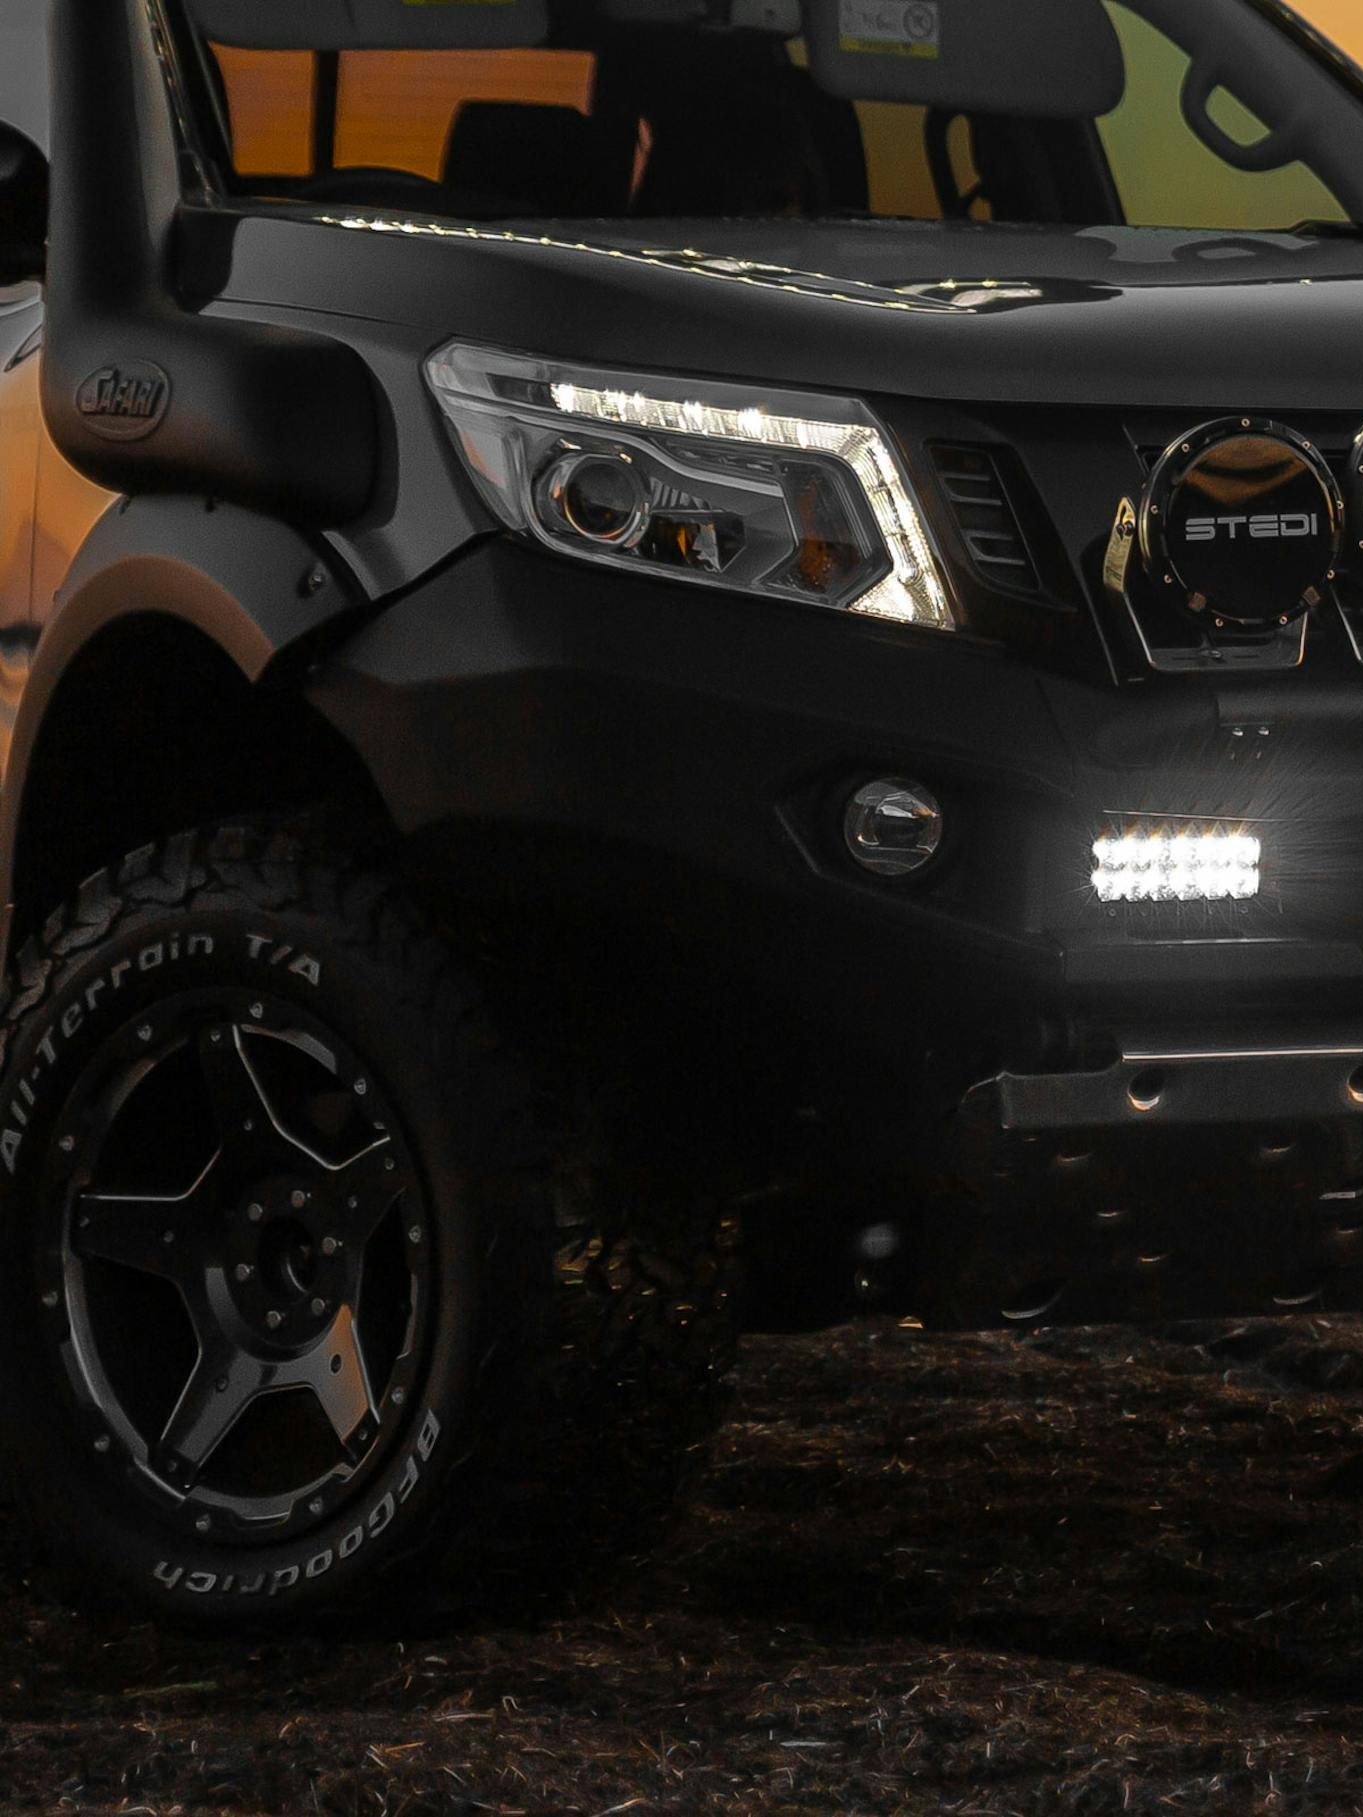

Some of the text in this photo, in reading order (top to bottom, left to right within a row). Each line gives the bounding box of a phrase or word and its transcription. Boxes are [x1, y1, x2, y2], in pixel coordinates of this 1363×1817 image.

[80, 368, 164, 417] SAFARI
[1184, 512, 1318, 541] STEDI
[245, 933, 321, 987] T/A
[152, 1408, 442, 1597] BFGoodrich
